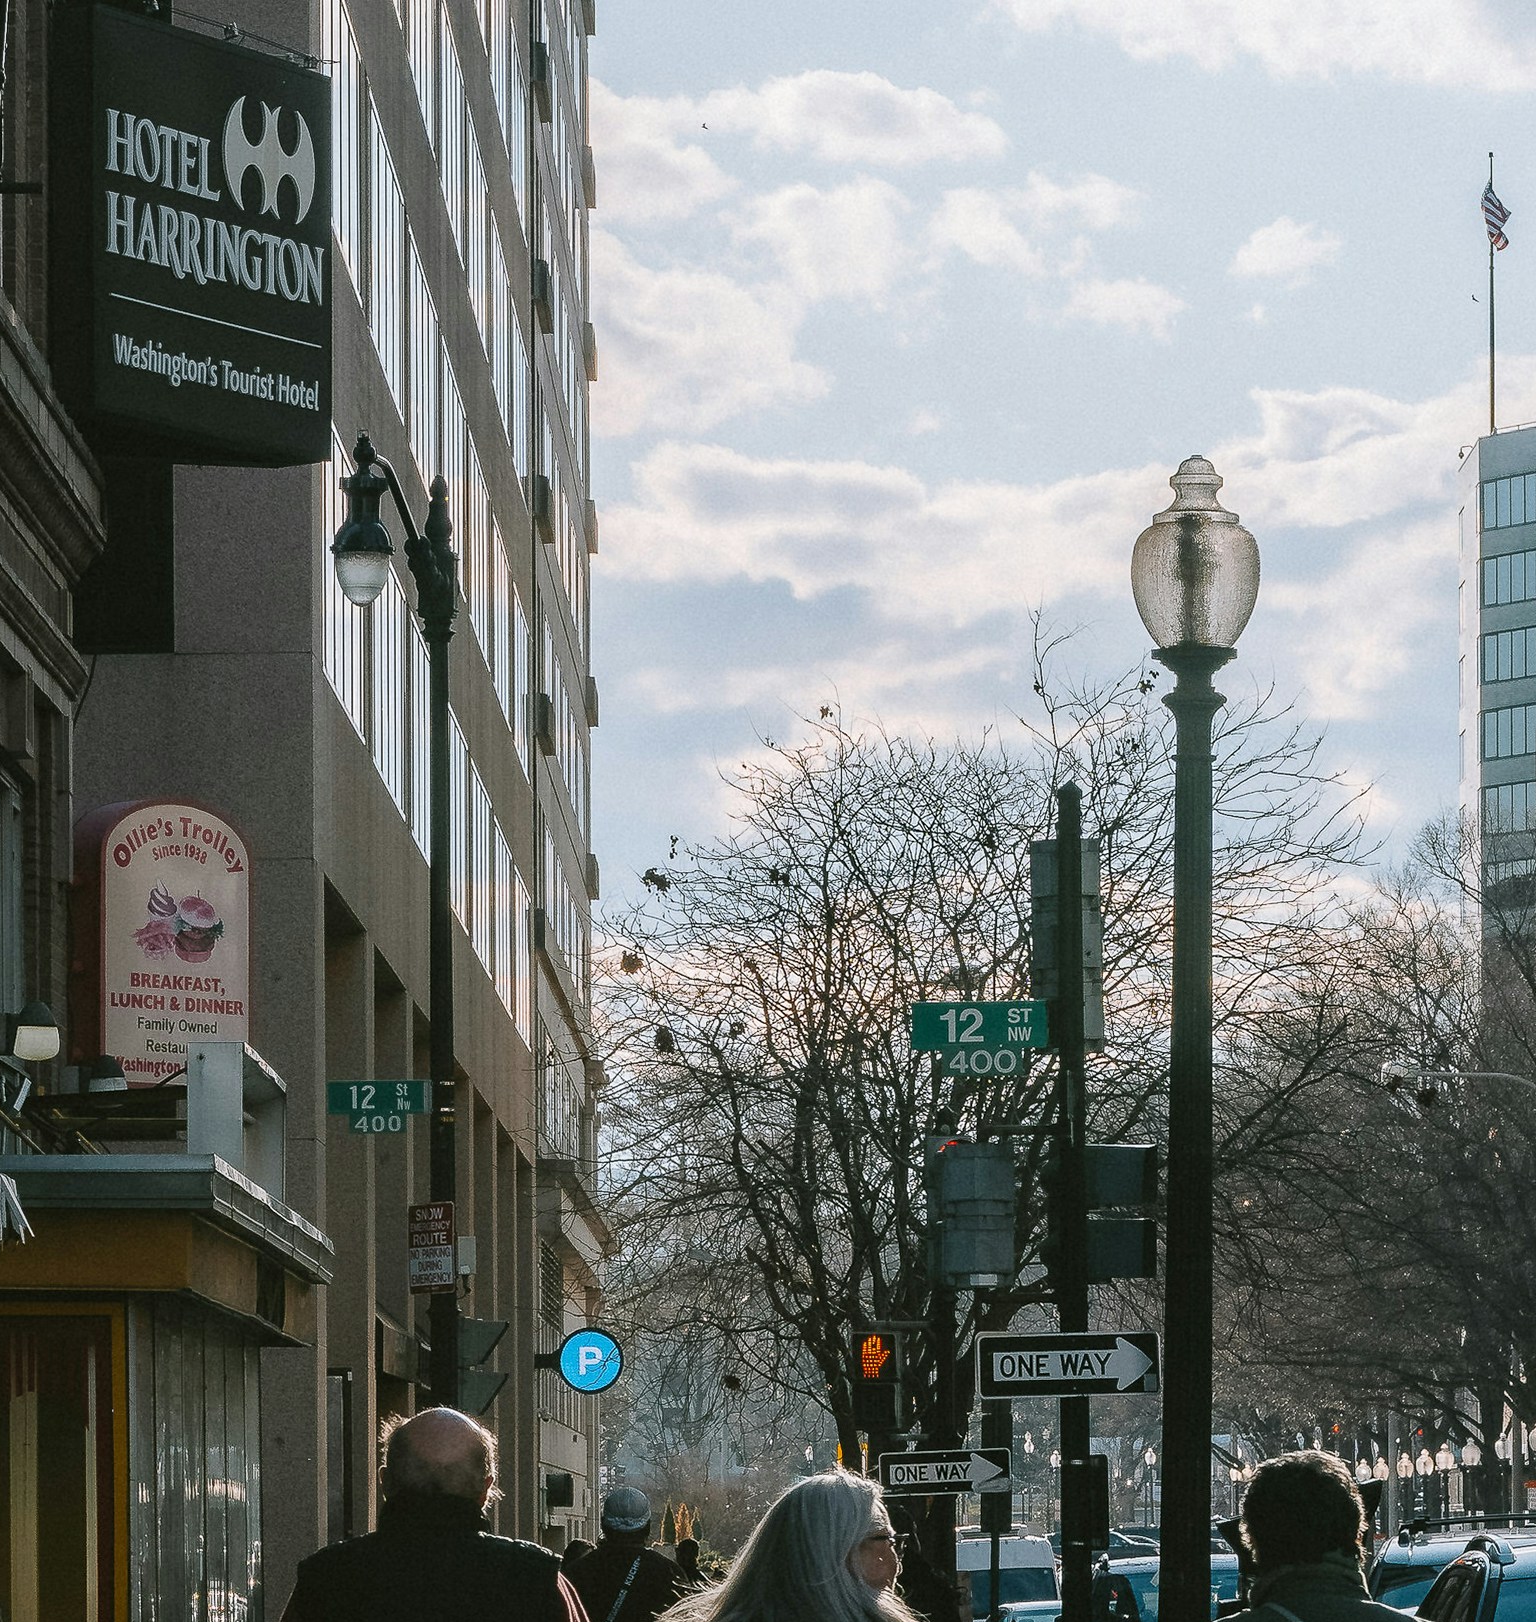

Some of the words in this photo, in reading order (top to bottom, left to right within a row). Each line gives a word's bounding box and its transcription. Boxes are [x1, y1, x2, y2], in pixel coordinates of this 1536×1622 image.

[105, 108, 220, 201] HOTEL
[106, 190, 324, 306] HARRINGTON
[114, 333, 218, 387] Washington's
[220, 360, 274, 402] Tourist
[278, 374, 319, 411] Hotel
[113, 817, 174, 868] Ollie's
[179, 817, 244, 875] Trolley
[153, 843, 181, 862] Since
[184, 843, 208, 865] 1938
[130, 972, 226, 996] BREAKFAST,
[111, 992, 164, 1011] LUNCH
[170, 996, 181, 1011] &
[184, 997, 244, 1016] DINNER
[137, 1016, 175, 1034] Family
[178, 1019, 217, 1034] Owned
[940, 1007, 984, 1043] 12
[1007, 1007, 1033, 1023] ST
[1007, 1026, 1032, 1042] NW
[949, 1049, 1017, 1074] 400
[349, 1085, 376, 1109] 12
[395, 1083, 408, 1096] St
[354, 1115, 402, 1132] 400
[415, 1206, 444, 1222] SNOW
[410, 1220, 451, 1233] EMERGENCY
[413, 1232, 447, 1246] ROUTE
[410, 1249, 419, 1260] NO
[421, 1246, 451, 1259] PARKING
[418, 1259, 443, 1272] DURING
[411, 1272, 452, 1285] EMERGENCY
[579, 1346, 603, 1375] P
[999, 1354, 1049, 1378] ONE
[1060, 1353, 1111, 1376] WAY
[894, 1464, 927, 1482] ONE
[935, 1463, 971, 1480] WAY
